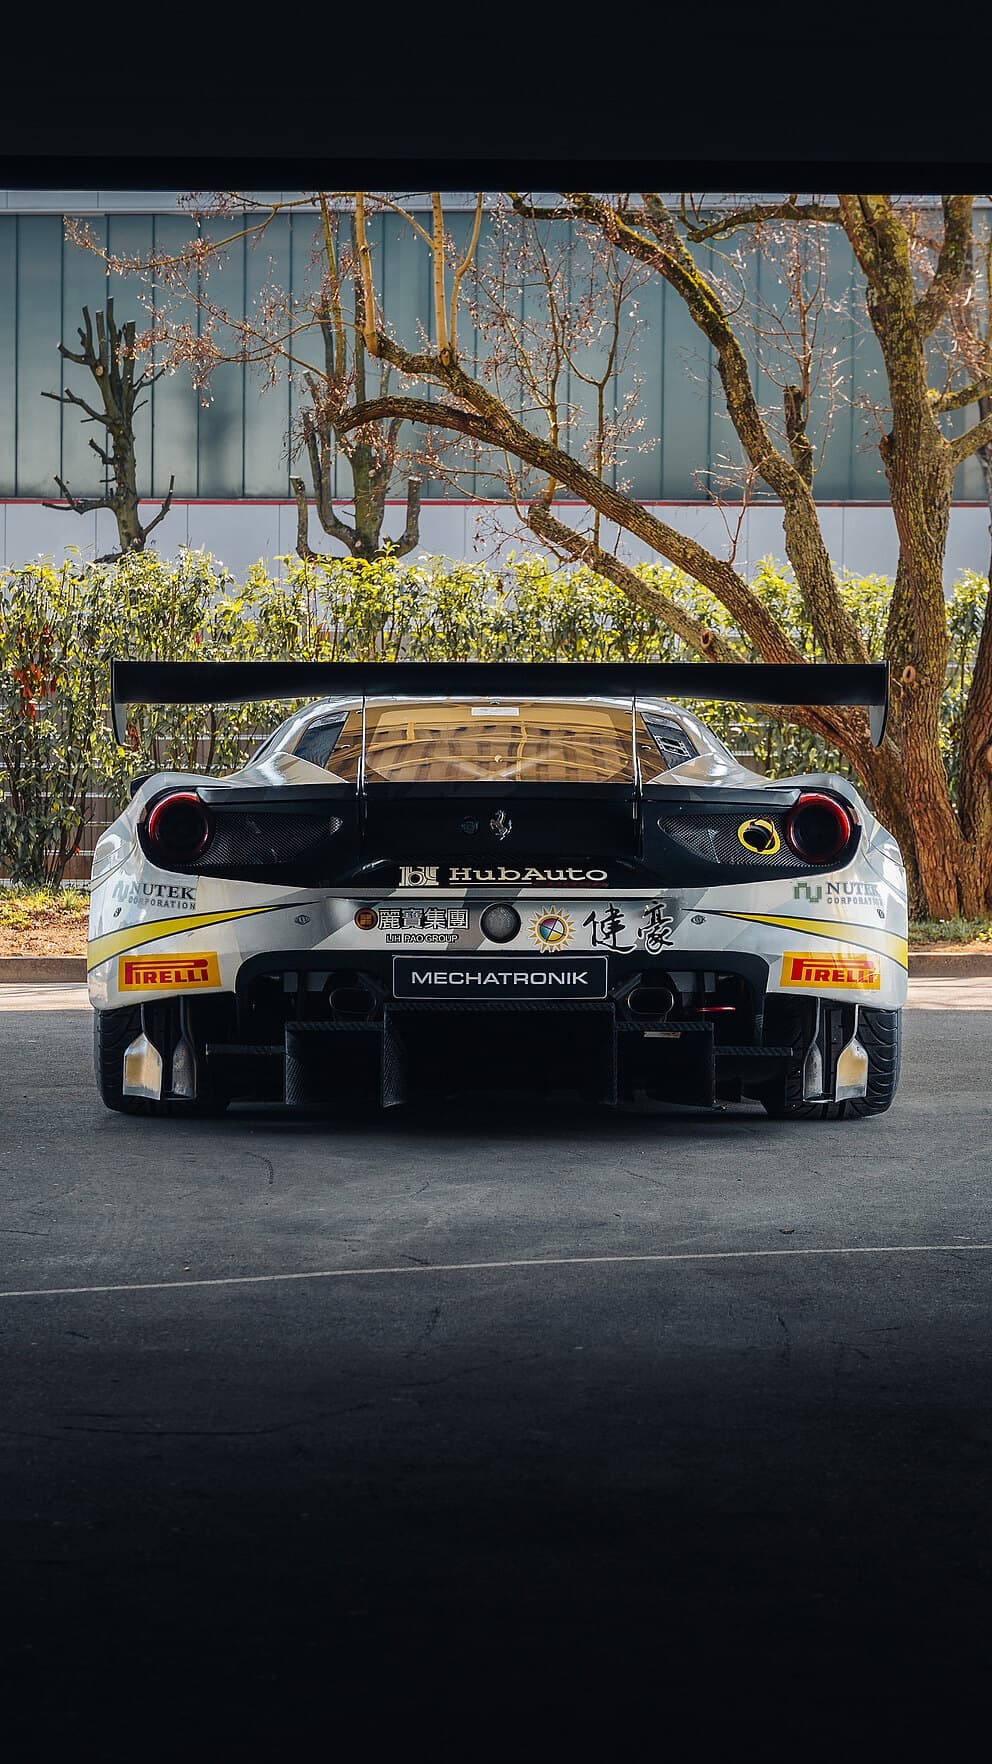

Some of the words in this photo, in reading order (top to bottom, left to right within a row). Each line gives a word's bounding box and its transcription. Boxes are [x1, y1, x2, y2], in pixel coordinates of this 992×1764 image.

[449, 866, 608, 881] HubAuto
[129, 882, 196, 901] NUTEK
[128, 895, 196, 911] CORPORATION
[378, 908, 469, 930] 麗寶集團
[582, 901, 675, 953] 健豪
[386, 933, 402, 943] LIH
[404, 933, 424, 943] PAO
[424, 933, 459, 943] GROUP
[124, 958, 209, 985] PIRELLI
[410, 970, 589, 986] MECHATRONIK
[790, 958, 876, 984] PIRELLI
